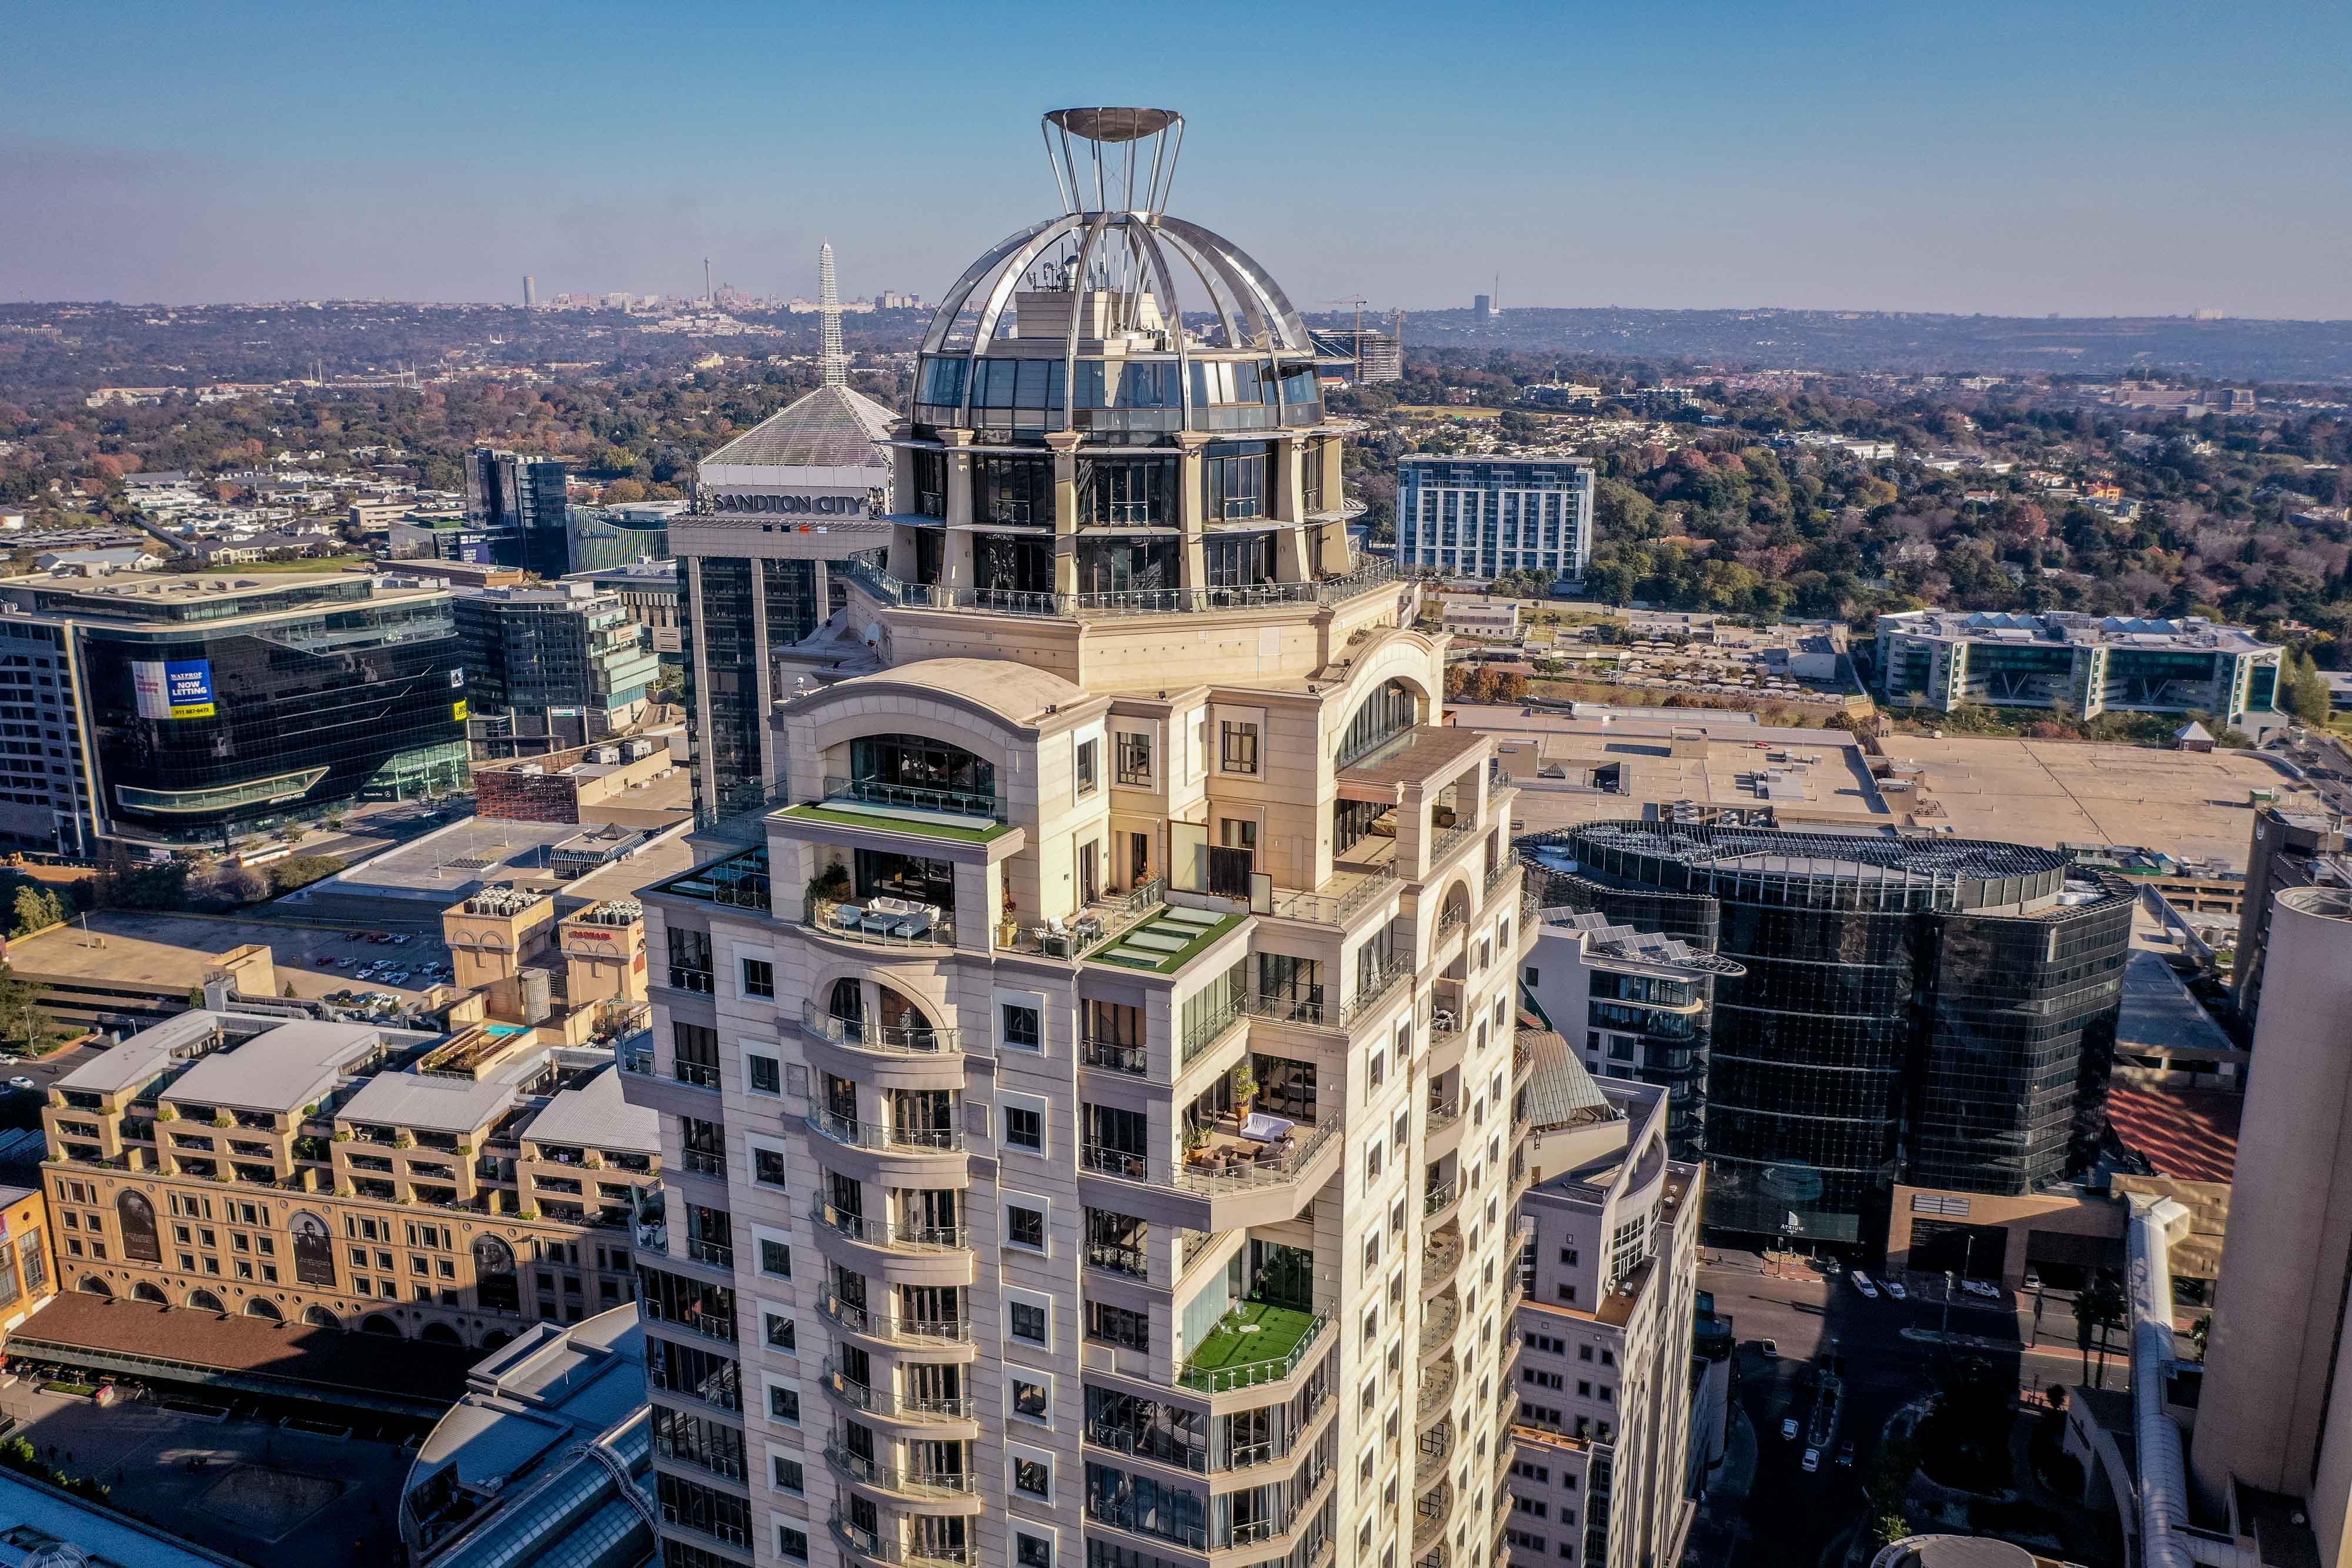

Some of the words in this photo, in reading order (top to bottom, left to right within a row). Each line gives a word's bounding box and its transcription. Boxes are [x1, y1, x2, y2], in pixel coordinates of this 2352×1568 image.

[714, 493, 813, 513] SANDTON
[821, 496, 865, 514] CITY
[172, 687, 208, 696] LETTING
[402, 761, 439, 773] Mercedes-Benz
[282, 792, 305, 801] AMG
